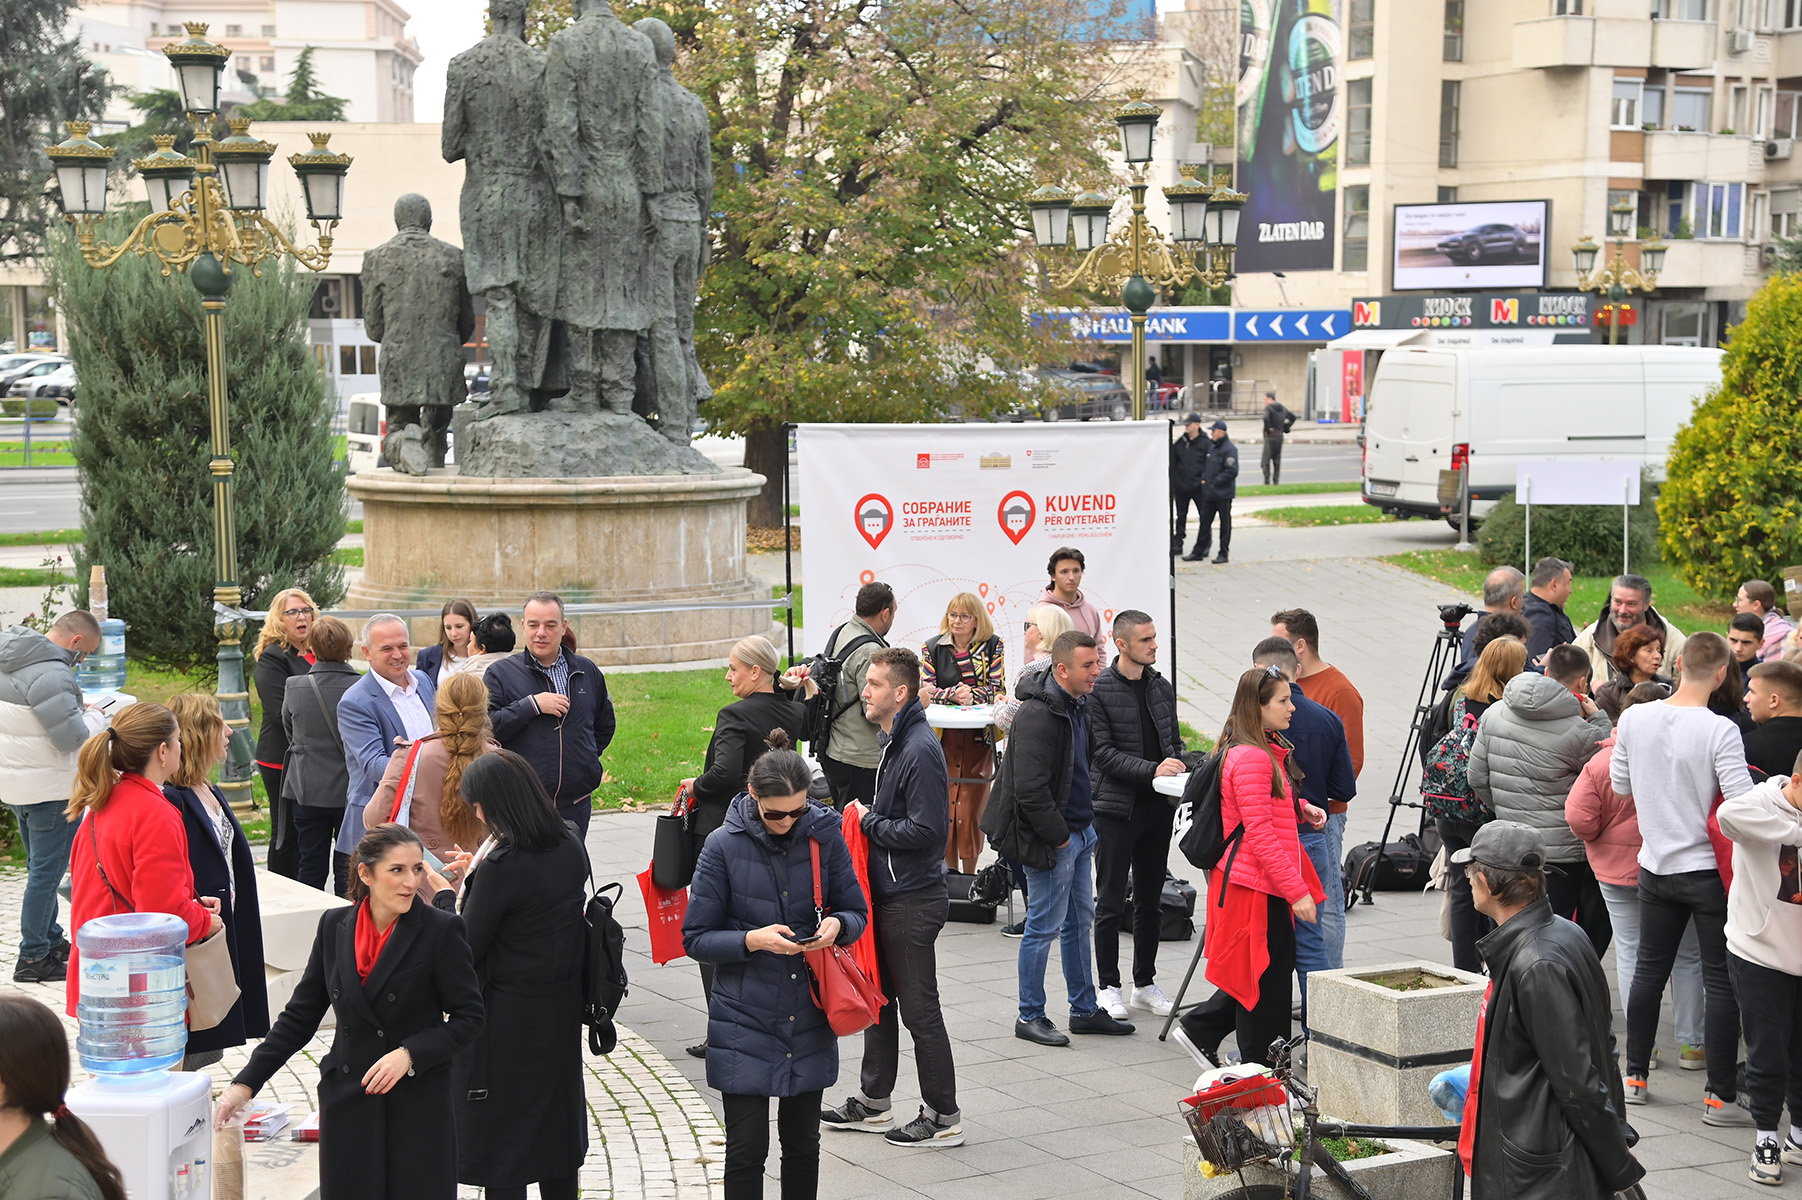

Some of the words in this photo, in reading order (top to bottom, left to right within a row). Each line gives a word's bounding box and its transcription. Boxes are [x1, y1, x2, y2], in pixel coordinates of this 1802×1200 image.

[1092, 317, 1188, 335] HALANK
[902, 501, 972, 515] СОБРАНИЕ
[1045, 494, 1116, 512] KUVEND
[903, 518, 915, 527] ЗА
[1044, 513, 1063, 526] PËR
[1064, 512, 1116, 525] QYTETARËT
